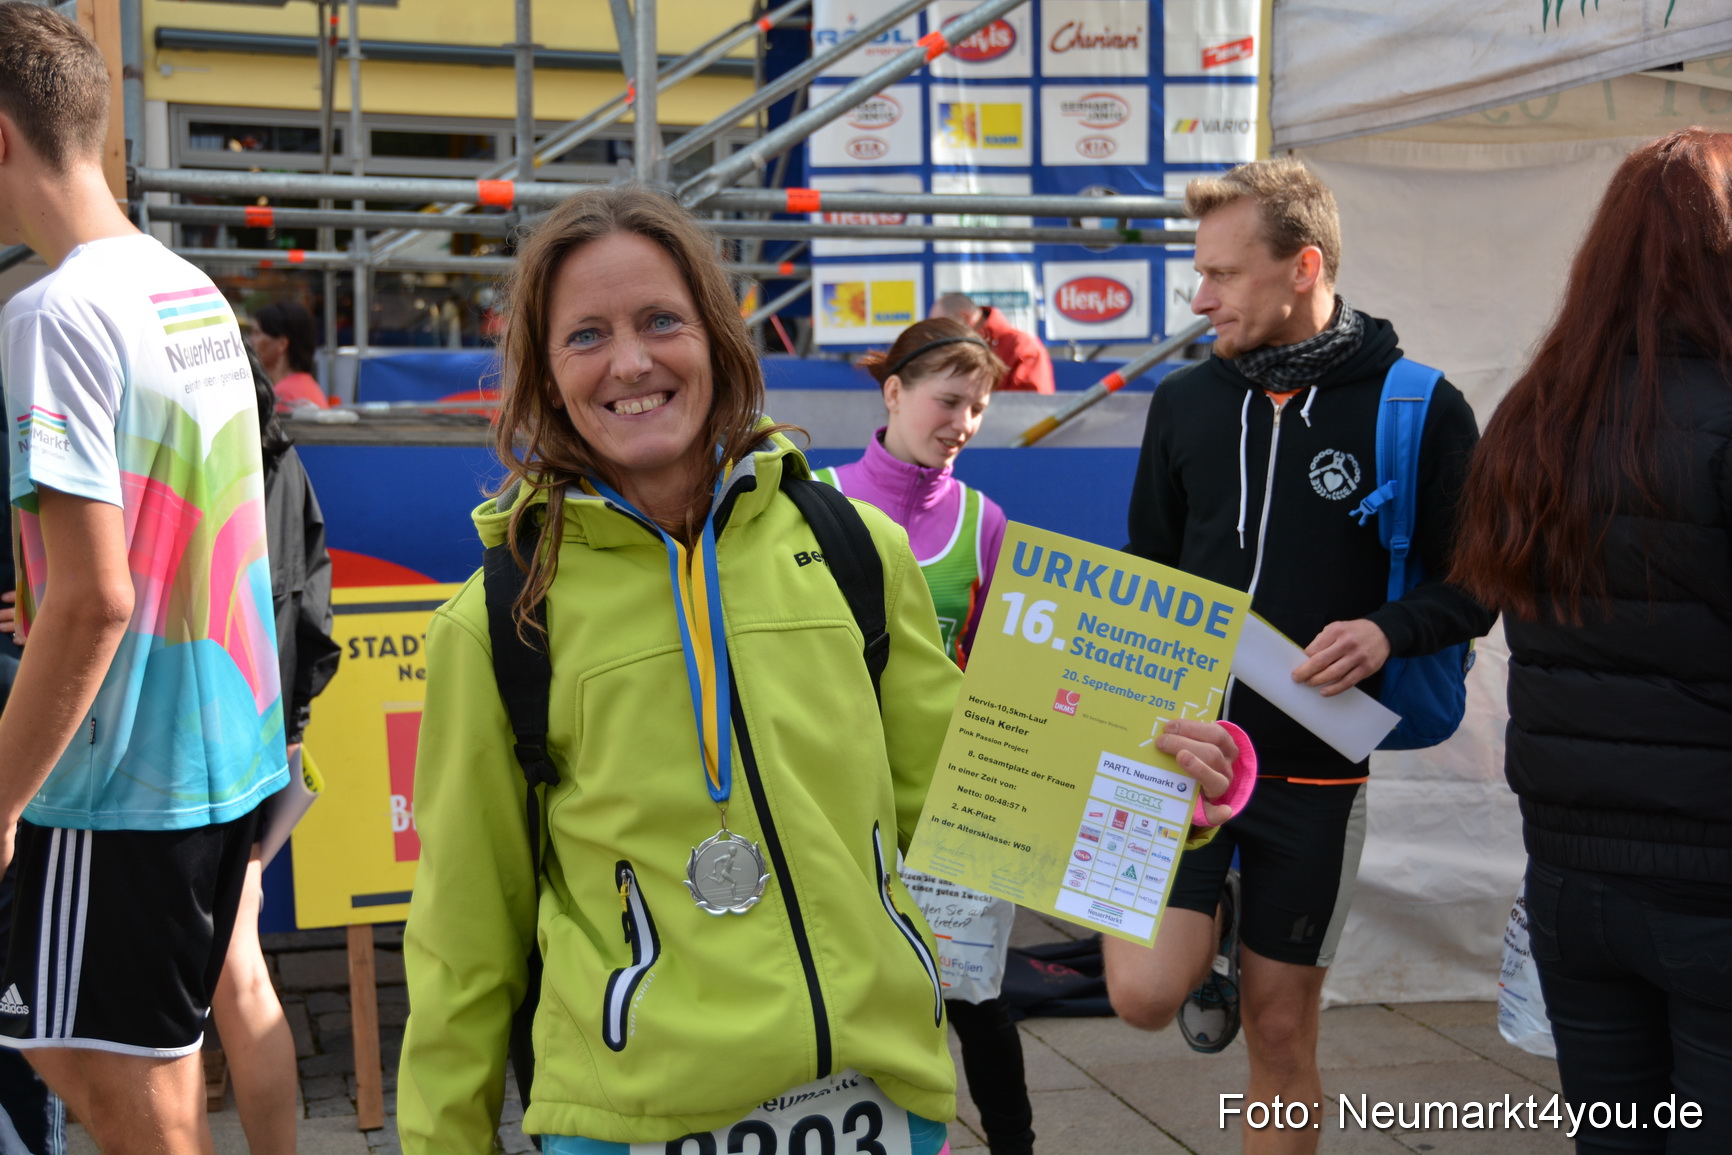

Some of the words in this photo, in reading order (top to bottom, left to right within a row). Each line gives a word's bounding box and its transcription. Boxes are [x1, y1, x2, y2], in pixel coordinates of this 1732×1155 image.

[1060, 286, 1128, 314] Hervis
[1012, 541, 1234, 638] URKUNDE
[1002, 592, 1065, 651] 16.
[1077, 612, 1218, 672] Neumarkter
[1070, 637, 1188, 691] Stadtlauf
[1062, 669, 1079, 683] 20.
[1082, 675, 1146, 703] September
[1148, 694, 1176, 711] 2015
[969, 695, 1048, 725] Hervis-10,5km-Lauf
[1054, 702, 1075, 715] DKMS
[964, 710, 995, 727] Gisela
[997, 718, 1029, 736] Kerler
[959, 727, 974, 737] Pink
[976, 732, 1001, 745] Passion
[1003, 740, 1029, 754] Project
[948, 763, 956, 771] In
[958, 766, 979, 777] einer
[982, 770, 998, 783] Zeit
[1000, 777, 1017, 790] von:
[968, 750, 976, 758] 8.
[978, 752, 1029, 778] Gesamtplatz
[1031, 769, 1046, 779] der
[1047, 774, 1075, 790] Frauen
[1103, 760, 1131, 775] PARTL
[1133, 770, 1174, 788] Neumarkt
[957, 785, 982, 799] Netto:
[985, 793, 1019, 811] 00:48:57
[1022, 804, 1027, 813] h
[1115, 786, 1163, 810] BOCK
[952, 802, 959, 810] 2.
[961, 805, 996, 823] AK-Platz
[931, 815, 939, 823] In
[941, 818, 955, 828] der
[956, 822, 1011, 847] Altersklasse:
[1013, 839, 1031, 853] W50
[936, 888, 959, 897] guten
[1087, 909, 1122, 924] NeuerMarkt
[0, 1002, 30, 1015] adidas
